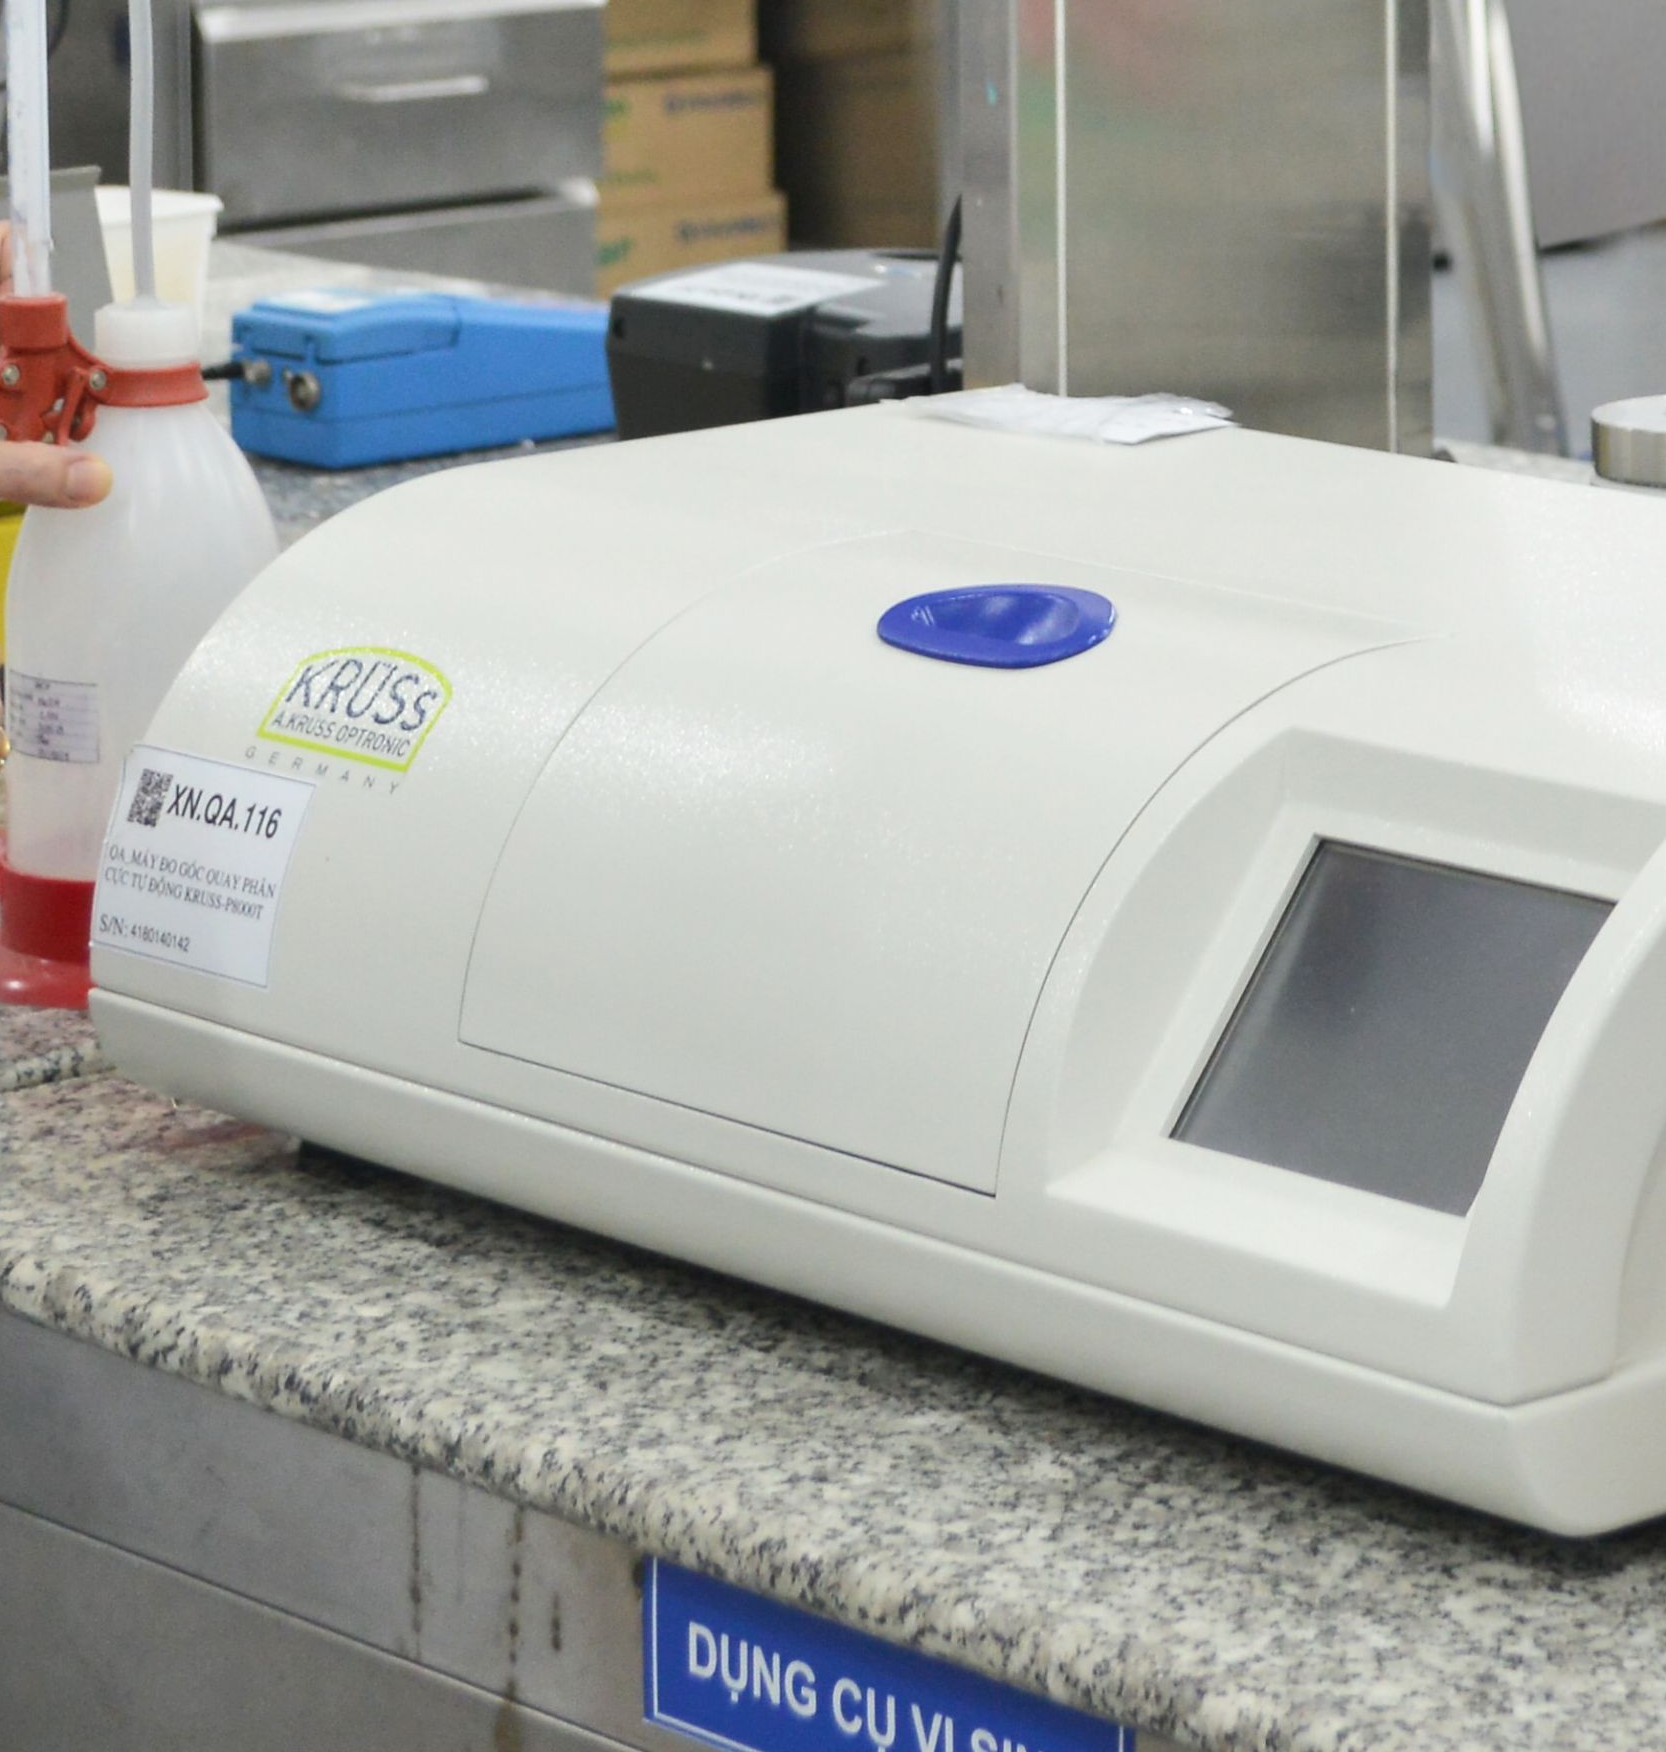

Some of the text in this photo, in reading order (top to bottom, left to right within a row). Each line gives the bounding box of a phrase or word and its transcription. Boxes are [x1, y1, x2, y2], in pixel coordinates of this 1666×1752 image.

[284, 658, 439, 732] KRÜSS
[336, 725, 412, 757] OPTRONIC
[167, 783, 283, 839] XN.QA.116
[148, 877, 182, 899] ĐỘNG
[159, 856, 178, 874] ĐO
[179, 860, 206, 882] GÓC
[206, 868, 242, 890] QUAY
[99, 913, 129, 938] S/N:
[688, 1621, 817, 1718] DỤNG
